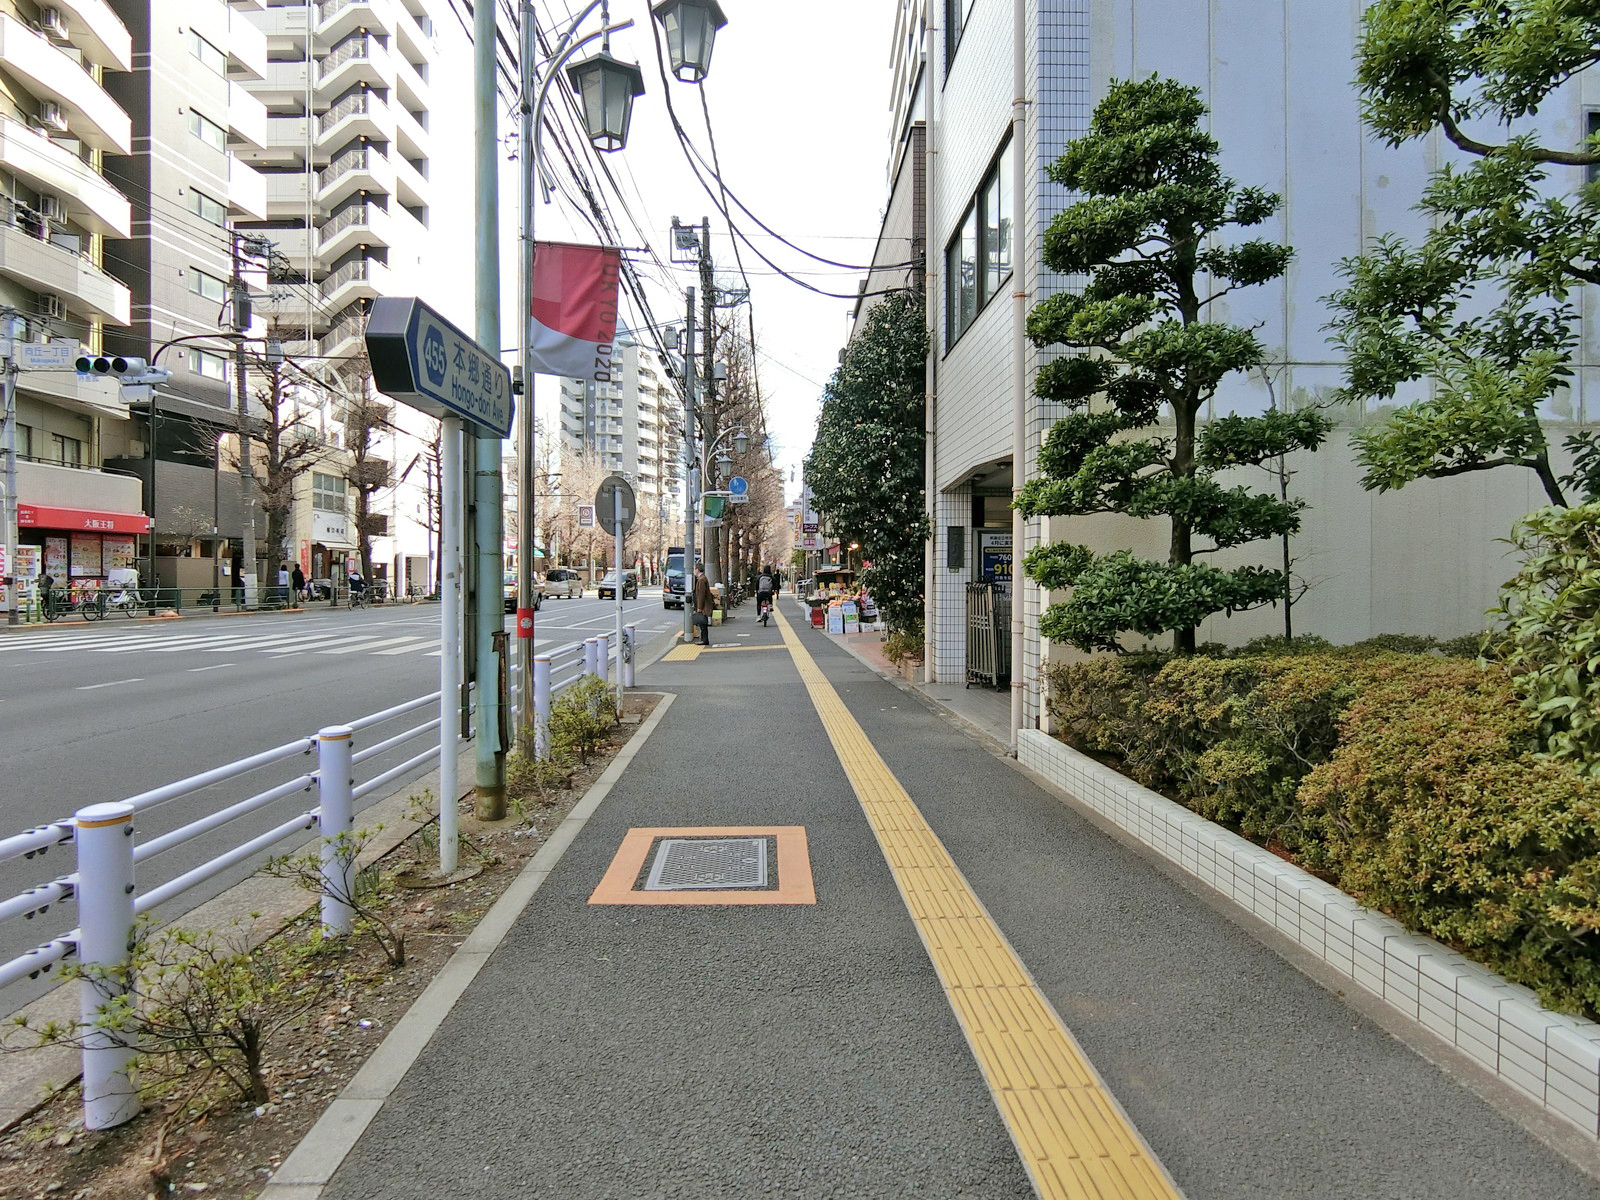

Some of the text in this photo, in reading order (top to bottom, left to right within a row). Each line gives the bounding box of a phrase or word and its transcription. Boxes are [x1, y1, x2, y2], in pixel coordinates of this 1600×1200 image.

[594, 250, 621, 383] TOKYO 2020
[25, 347, 69, 357] 向丘一丁目
[424, 337, 446, 377] 455
[452, 340, 503, 401] 本郷通り
[451, 374, 505, 426] Hongo-dori Ave.
[84, 519, 114, 529] 大阪王将
